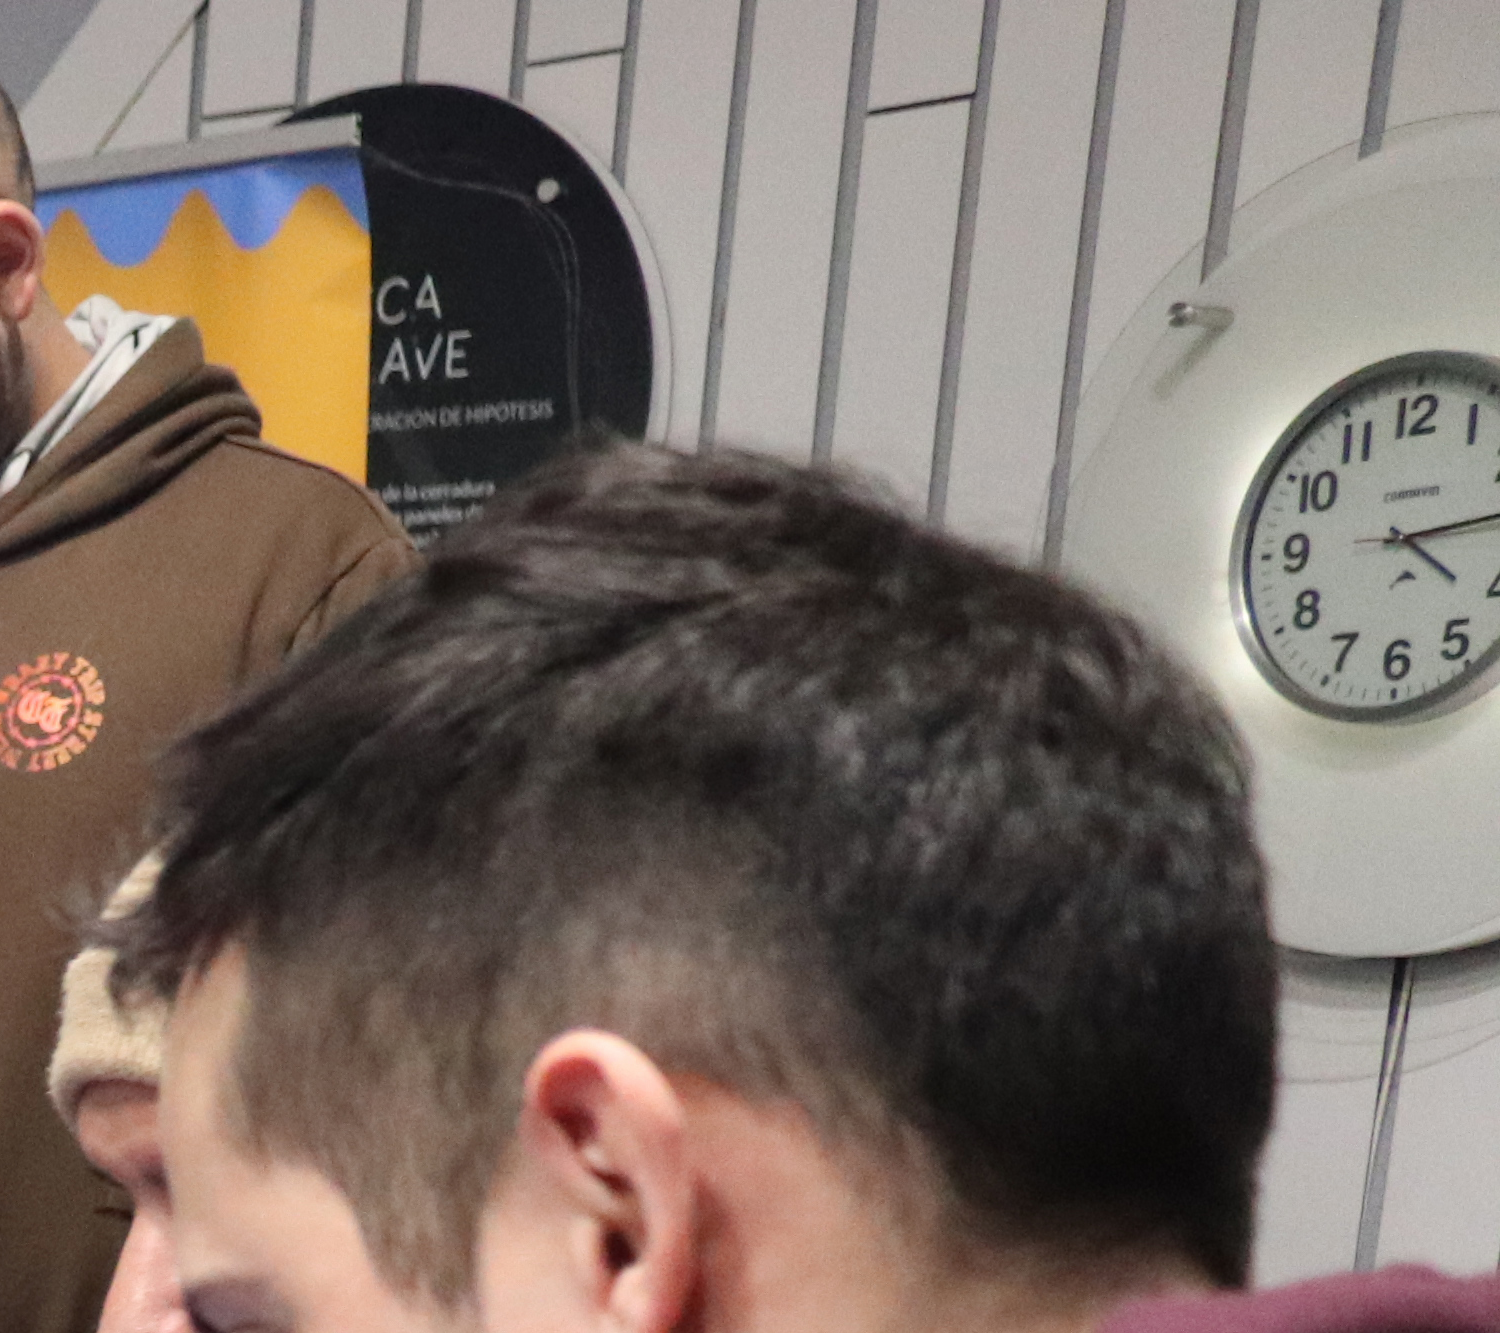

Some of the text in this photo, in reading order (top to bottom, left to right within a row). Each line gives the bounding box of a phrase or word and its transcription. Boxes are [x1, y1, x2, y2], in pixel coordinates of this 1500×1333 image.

[375, 272, 444, 326] CA
[377, 329, 473, 385] AVE
[1396, 393, 1440, 440] 12
[1466, 403, 1479, 445] 1
[1341, 420, 1372, 464] 11
[1299, 469, 1339, 514] 10
[1283, 532, 1311, 574] 9
[1292, 588, 1321, 630] 8
[1330, 631, 1360, 674] 7
[1383, 638, 1412, 682] 6
[1440, 617, 1470, 661] 5
